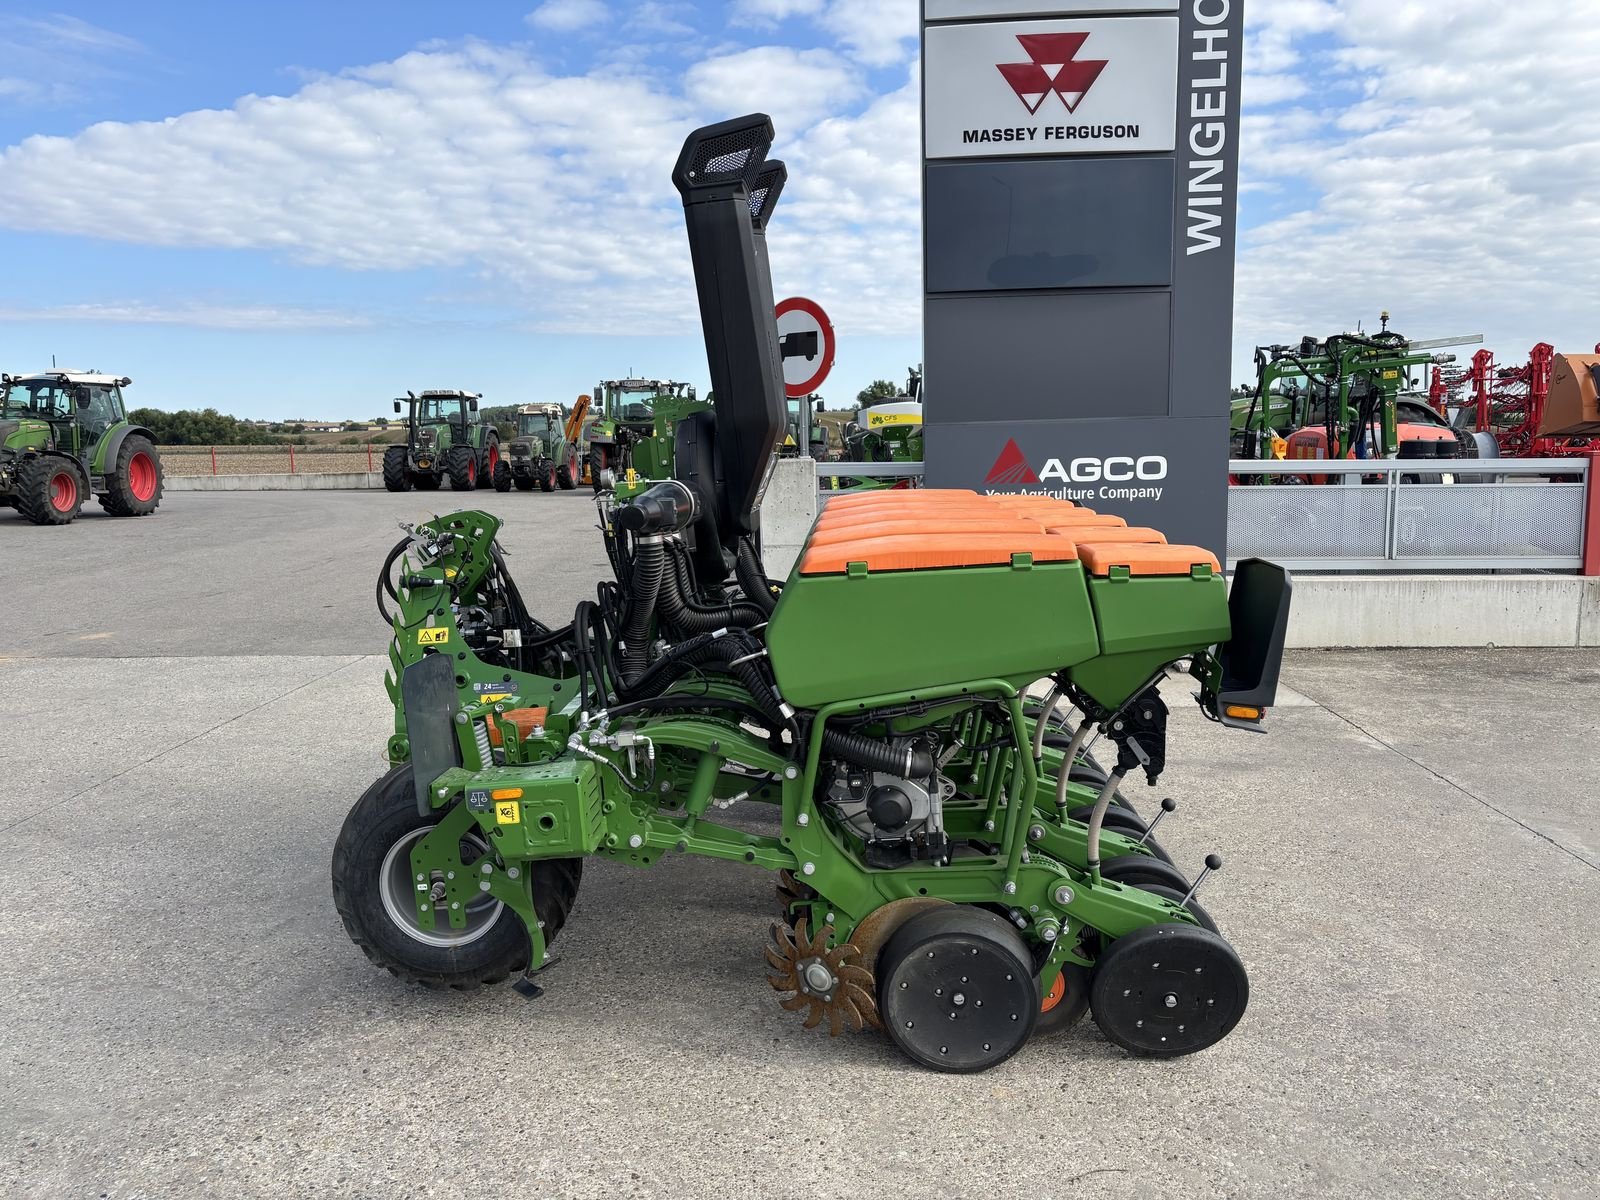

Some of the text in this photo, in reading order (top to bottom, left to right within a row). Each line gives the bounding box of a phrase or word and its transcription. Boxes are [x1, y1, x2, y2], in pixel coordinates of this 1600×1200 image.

[963, 125, 1140, 143] MASSEY FERGUSON
[1038, 455, 1168, 483] AGCO
[1099, 485, 1163, 502] Company
